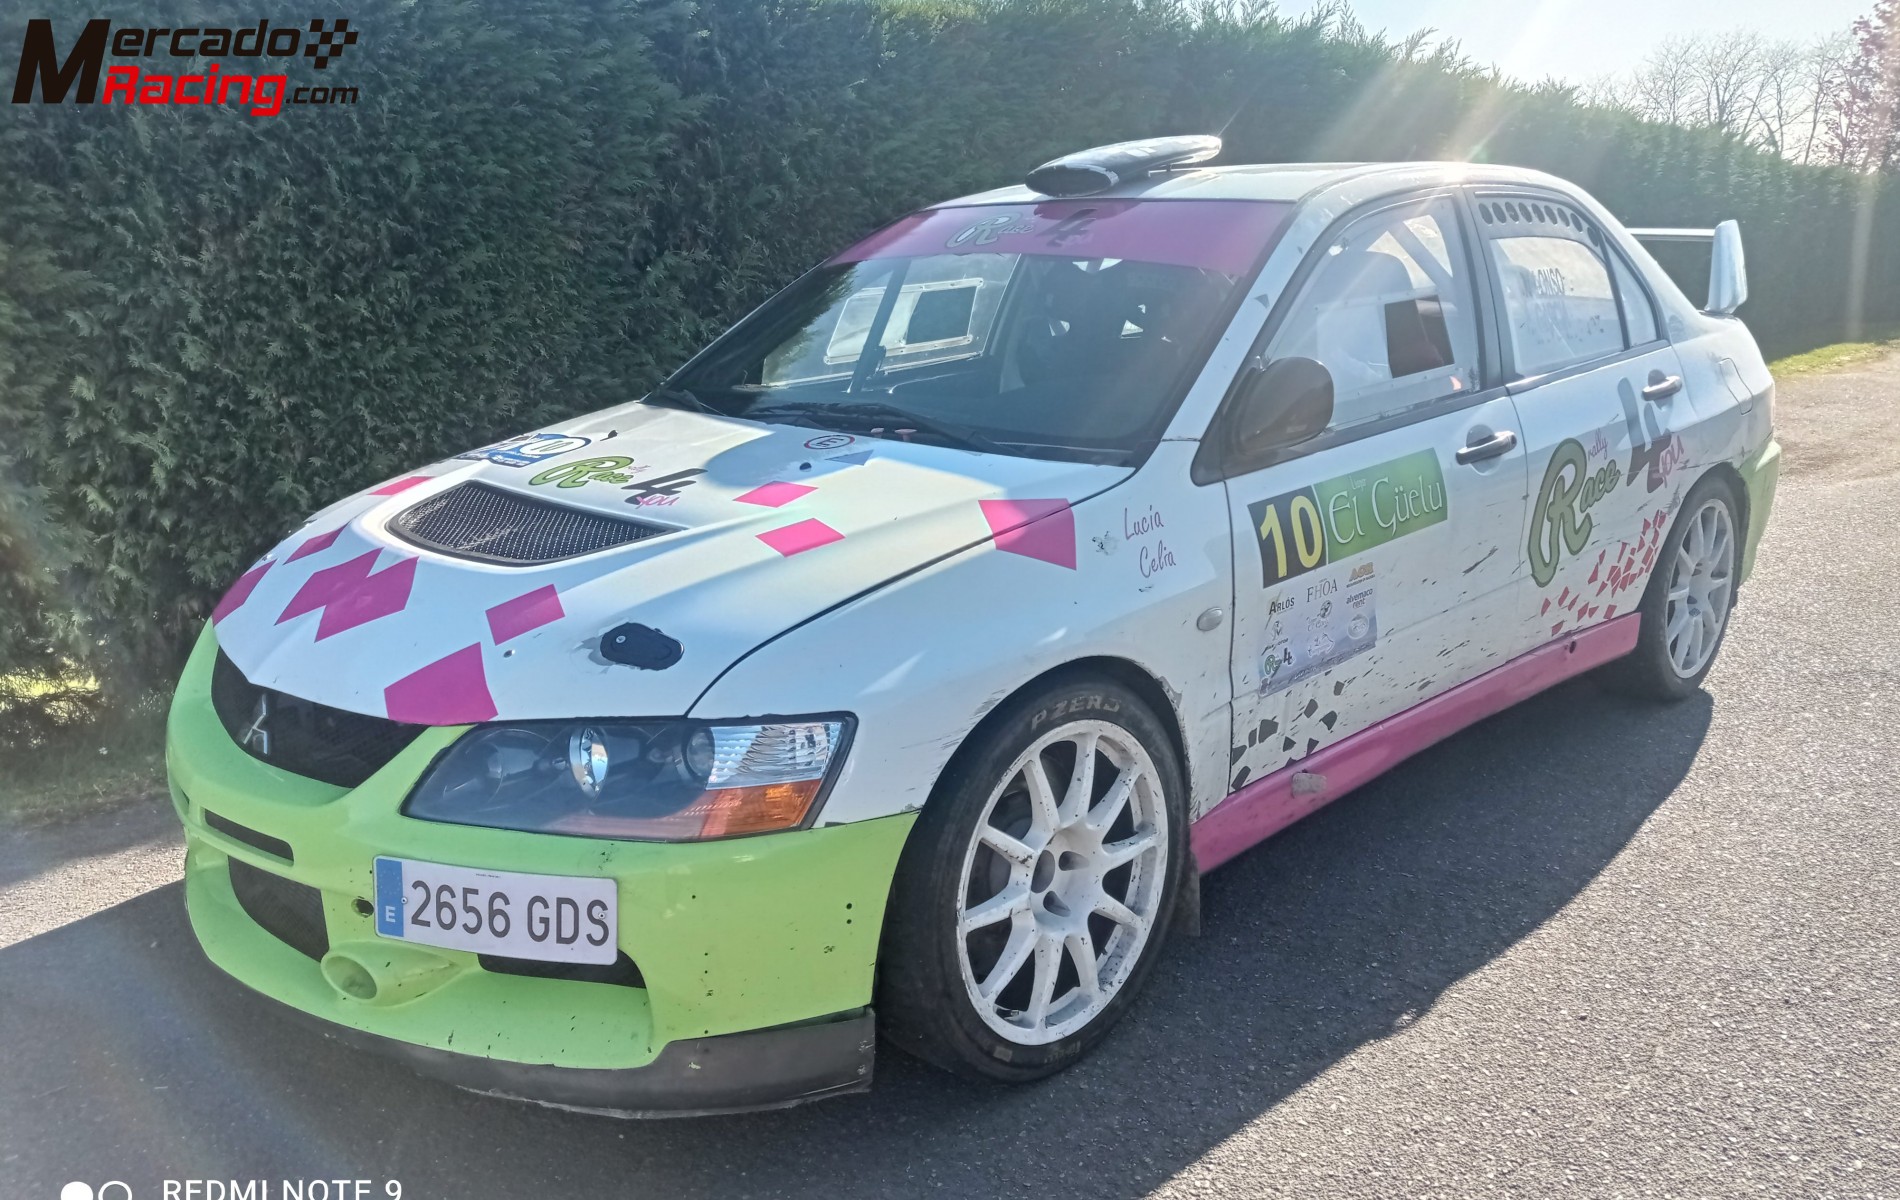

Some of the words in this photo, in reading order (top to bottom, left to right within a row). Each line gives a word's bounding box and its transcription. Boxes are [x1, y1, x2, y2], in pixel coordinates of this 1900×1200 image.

[528, 455, 635, 489] Race
[620, 467, 709, 507] 4
[1528, 438, 1621, 588] Race
[1617, 376, 1672, 494] 4
[1260, 495, 1323, 579] 10
[1328, 490, 1365, 544] El
[1371, 474, 1443, 536] Güelu
[1139, 540, 1177, 579] Celia
[1306, 578, 1339, 603] FHOA
[1030, 709, 1048, 731] P
[384, 905, 396, 924] E
[411, 879, 512, 939] 2656
[527, 895, 610, 947] GDS
